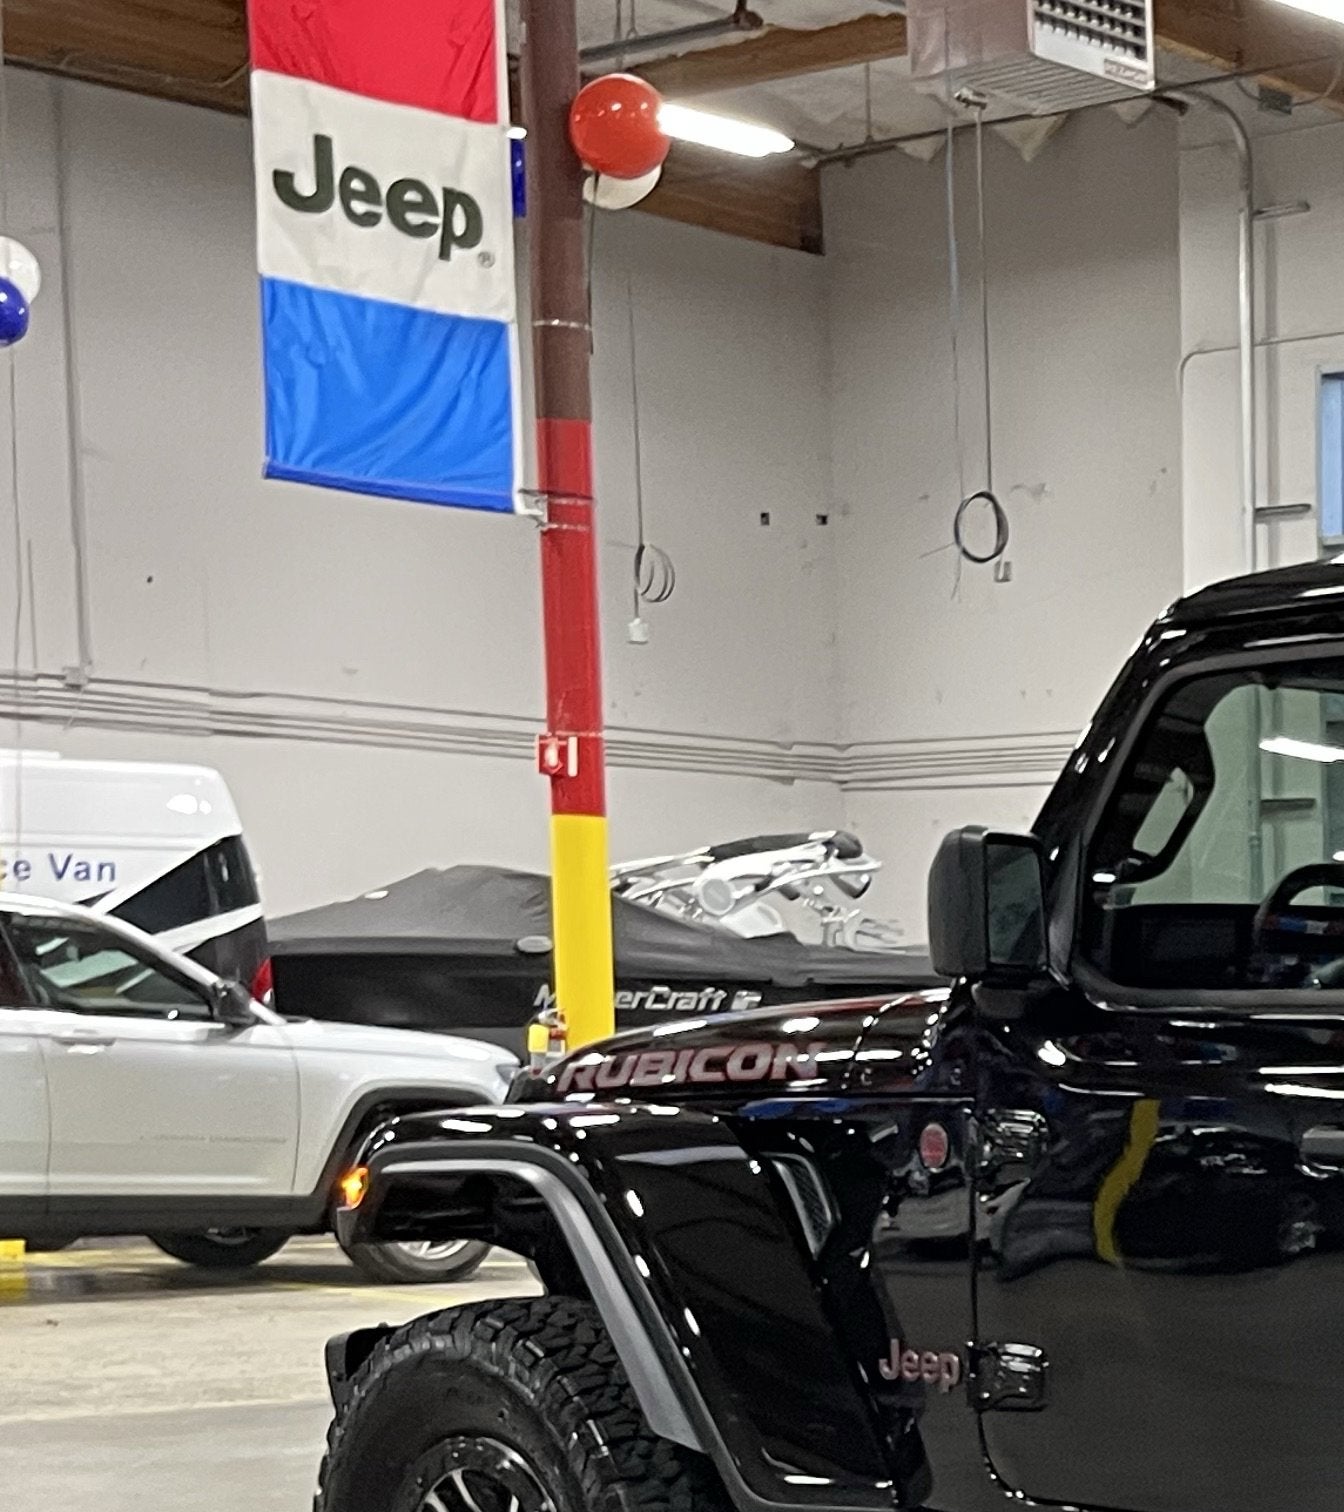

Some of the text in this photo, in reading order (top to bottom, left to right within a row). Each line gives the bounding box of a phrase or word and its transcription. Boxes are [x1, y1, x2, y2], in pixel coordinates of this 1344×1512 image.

[272, 133, 484, 262] Jeep
[48, 852, 116, 882] Van
[533, 983, 728, 1012] MerCraft
[556, 1042, 827, 1092] RUBICON
[878, 1338, 960, 1393] Jeep
